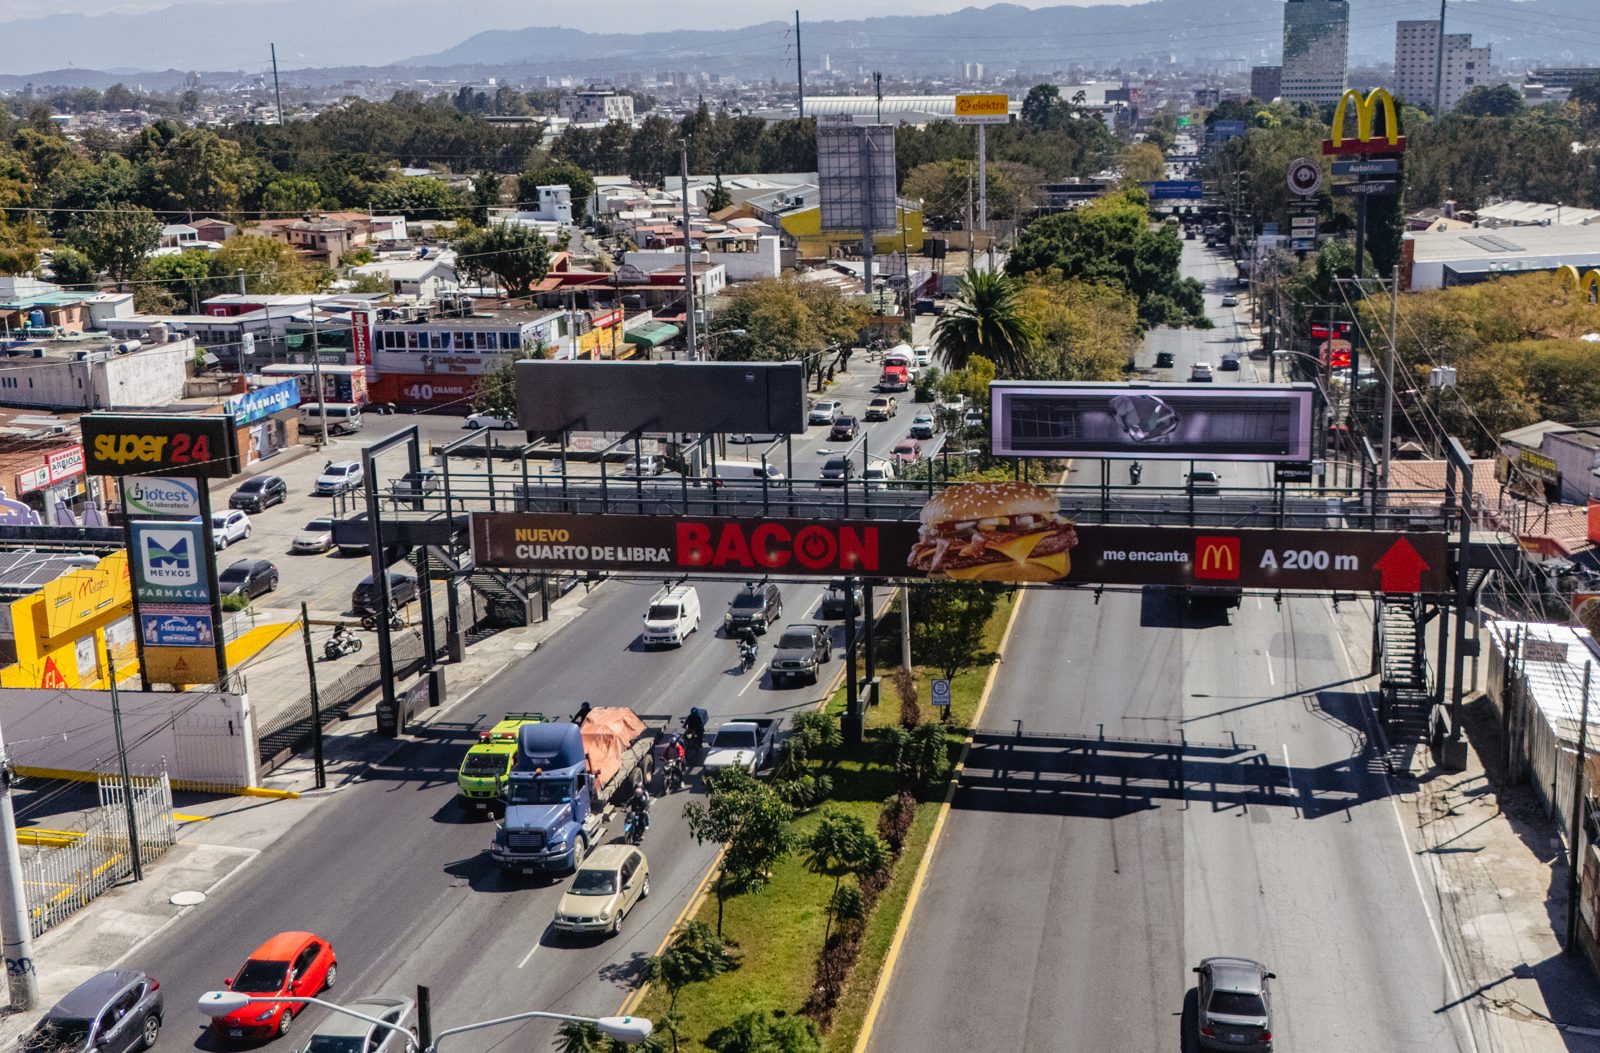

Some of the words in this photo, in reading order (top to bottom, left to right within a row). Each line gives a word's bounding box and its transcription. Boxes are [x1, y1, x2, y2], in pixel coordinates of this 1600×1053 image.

[972, 101, 1005, 110] elektra
[1349, 164, 1382, 172] AutoMac
[94, 434, 168, 464] super
[171, 433, 210, 462] 24
[515, 529, 569, 542] NUEVO
[676, 522, 879, 570] BACON
[516, 545, 588, 561] CUARTO
[591, 546, 615, 561] DE
[1103, 551, 1126, 560] me
[1128, 550, 1188, 562] encanta
[1259, 549, 1278, 569] A
[1282, 550, 1329, 570] 200
[1335, 554, 1359, 570] m
[150, 569, 191, 577] MEYKOS
[138, 588, 206, 598] FARMACIA
